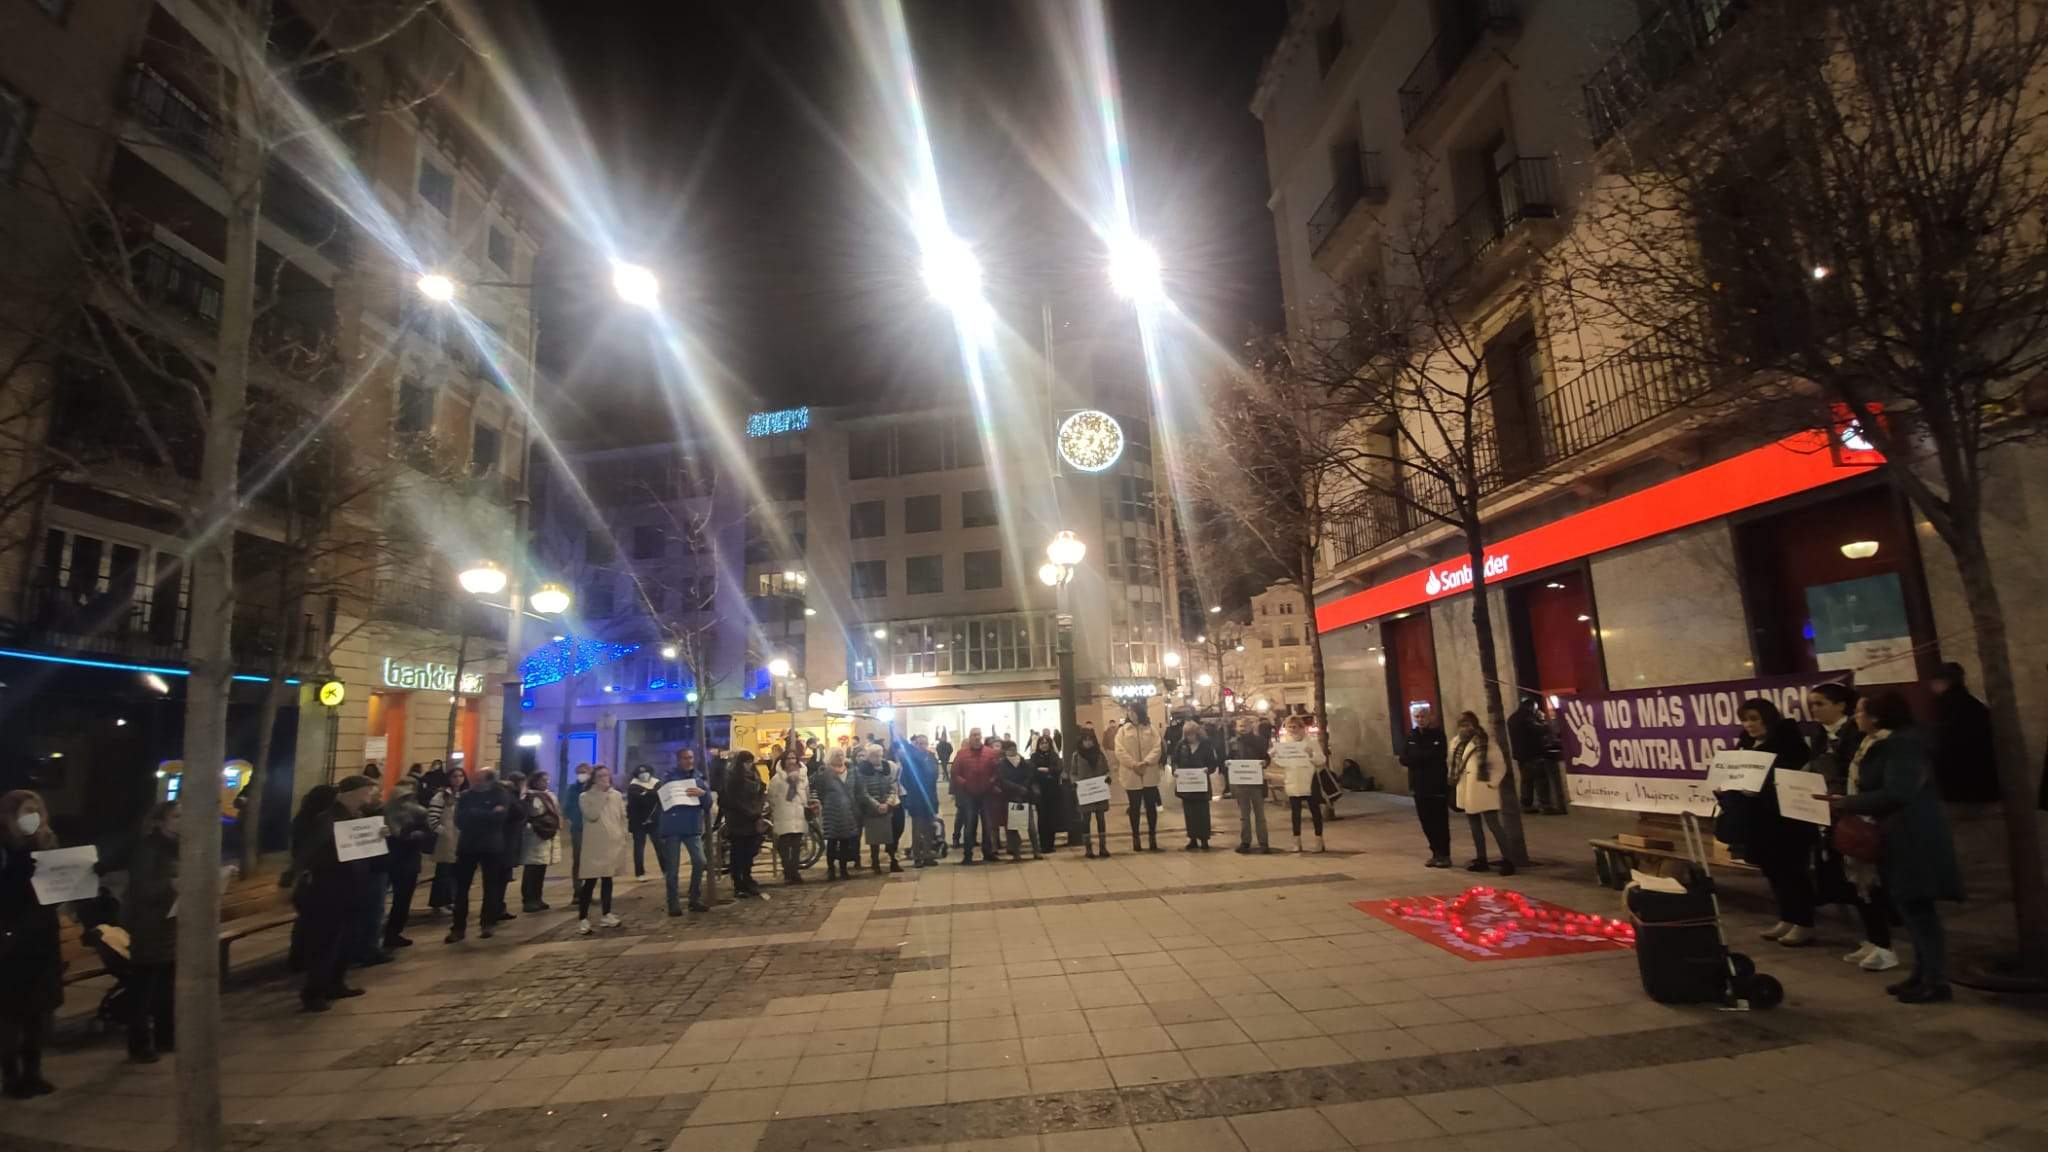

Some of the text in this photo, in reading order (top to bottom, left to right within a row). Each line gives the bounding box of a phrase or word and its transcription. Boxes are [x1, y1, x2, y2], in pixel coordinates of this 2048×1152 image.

[1603, 699, 1632, 729] NO
[1636, 690, 1686, 728] MÁS
[1609, 737, 1686, 770] CONTRA
